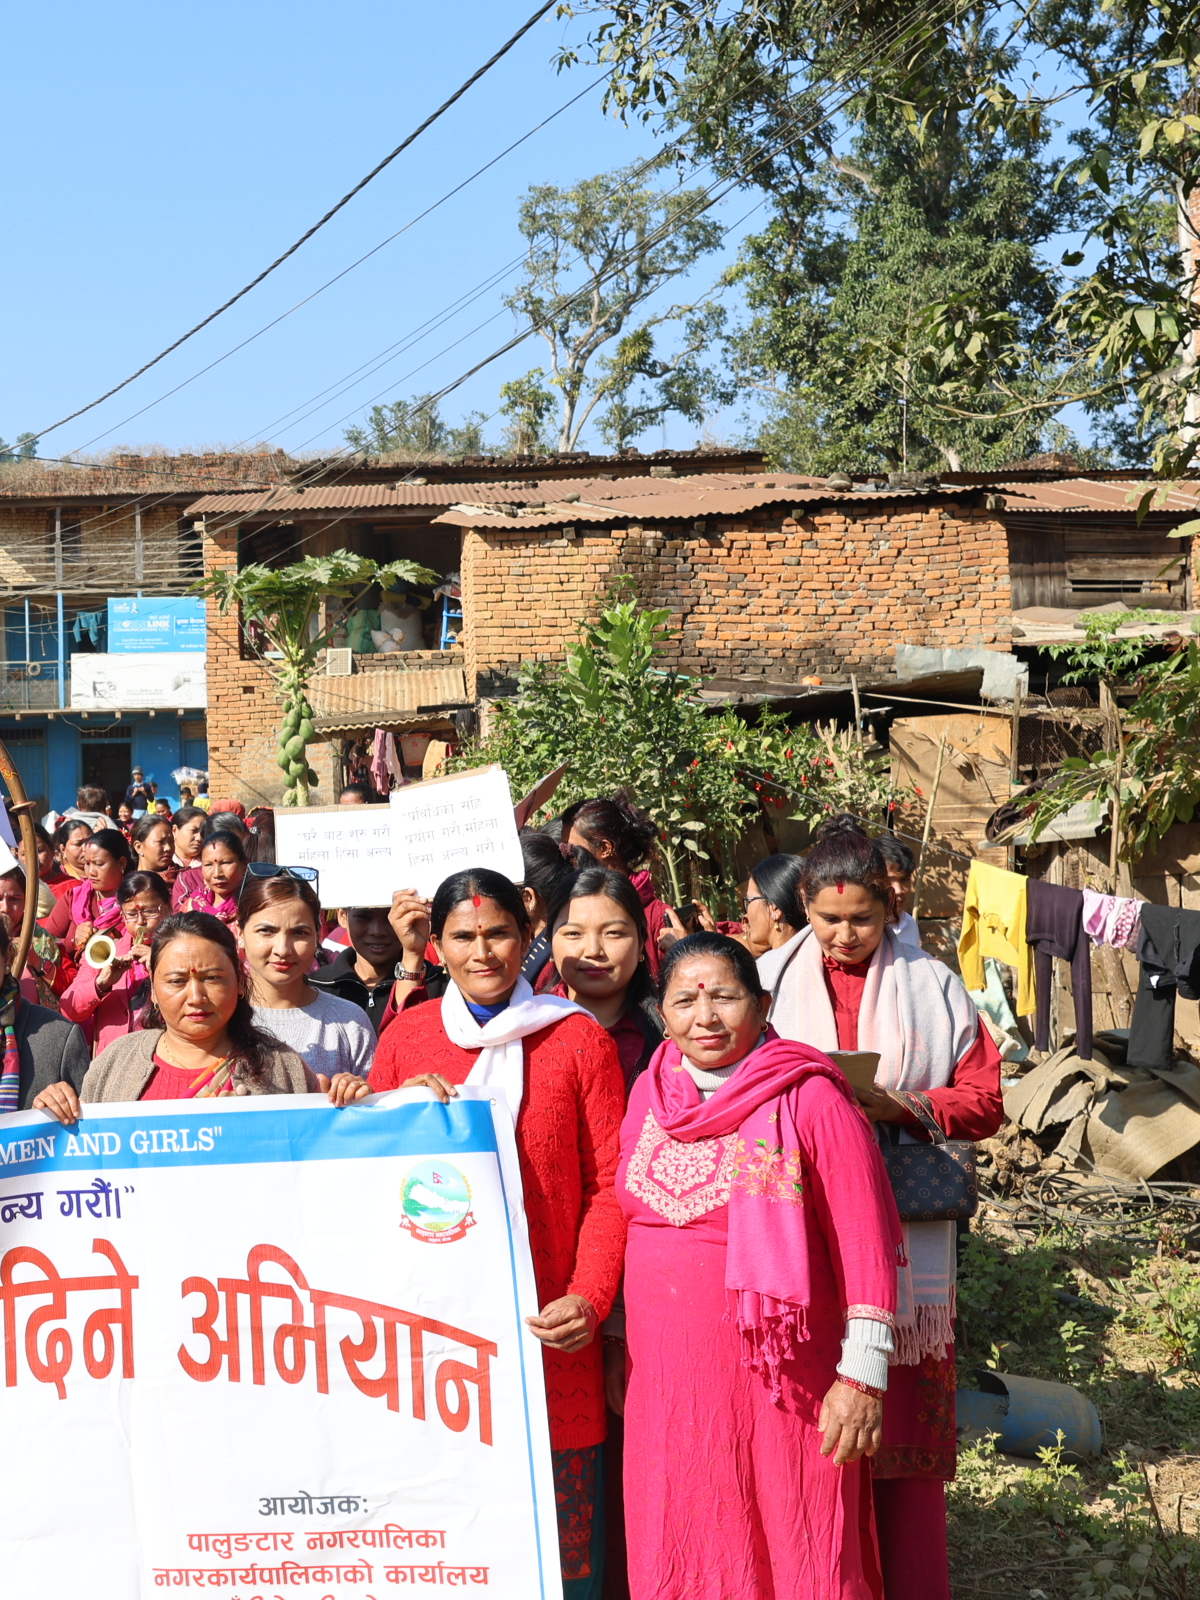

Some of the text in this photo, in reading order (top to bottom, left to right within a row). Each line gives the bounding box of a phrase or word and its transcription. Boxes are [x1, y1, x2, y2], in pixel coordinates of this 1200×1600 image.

[62, 1132, 121, 1158] AND
[177, 1242, 498, 1447] अभियान
[304, 1523, 446, 1551] नगरपालिका
[152, 1558, 490, 1588] नगरकार्यपालिकाको कार्यालय
